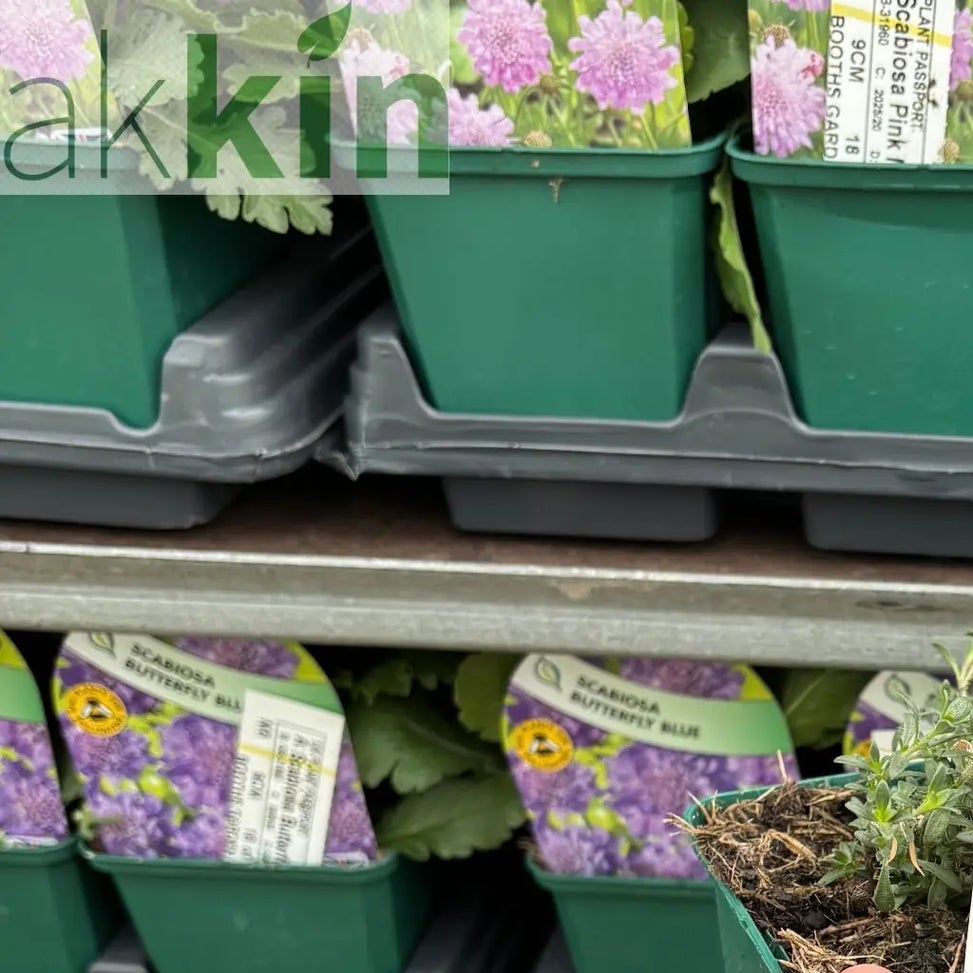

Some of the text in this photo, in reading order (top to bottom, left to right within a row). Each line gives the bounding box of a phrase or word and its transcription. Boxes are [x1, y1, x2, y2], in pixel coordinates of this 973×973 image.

[891, 0, 917, 95] Scabiosa
[917, 0, 932, 47] PLANT
[824, 15, 845, 159] BOOTHS GARD
[845, 39, 866, 155] 9CM 18
[887, 103, 909, 151] Pink
[125, 658, 210, 703] BUTTERFLY
[131, 641, 216, 689] SCABIOSA
[570, 689, 700, 738] BUTTERFLY BLUE
[577, 675, 661, 715] SCABIOSA
